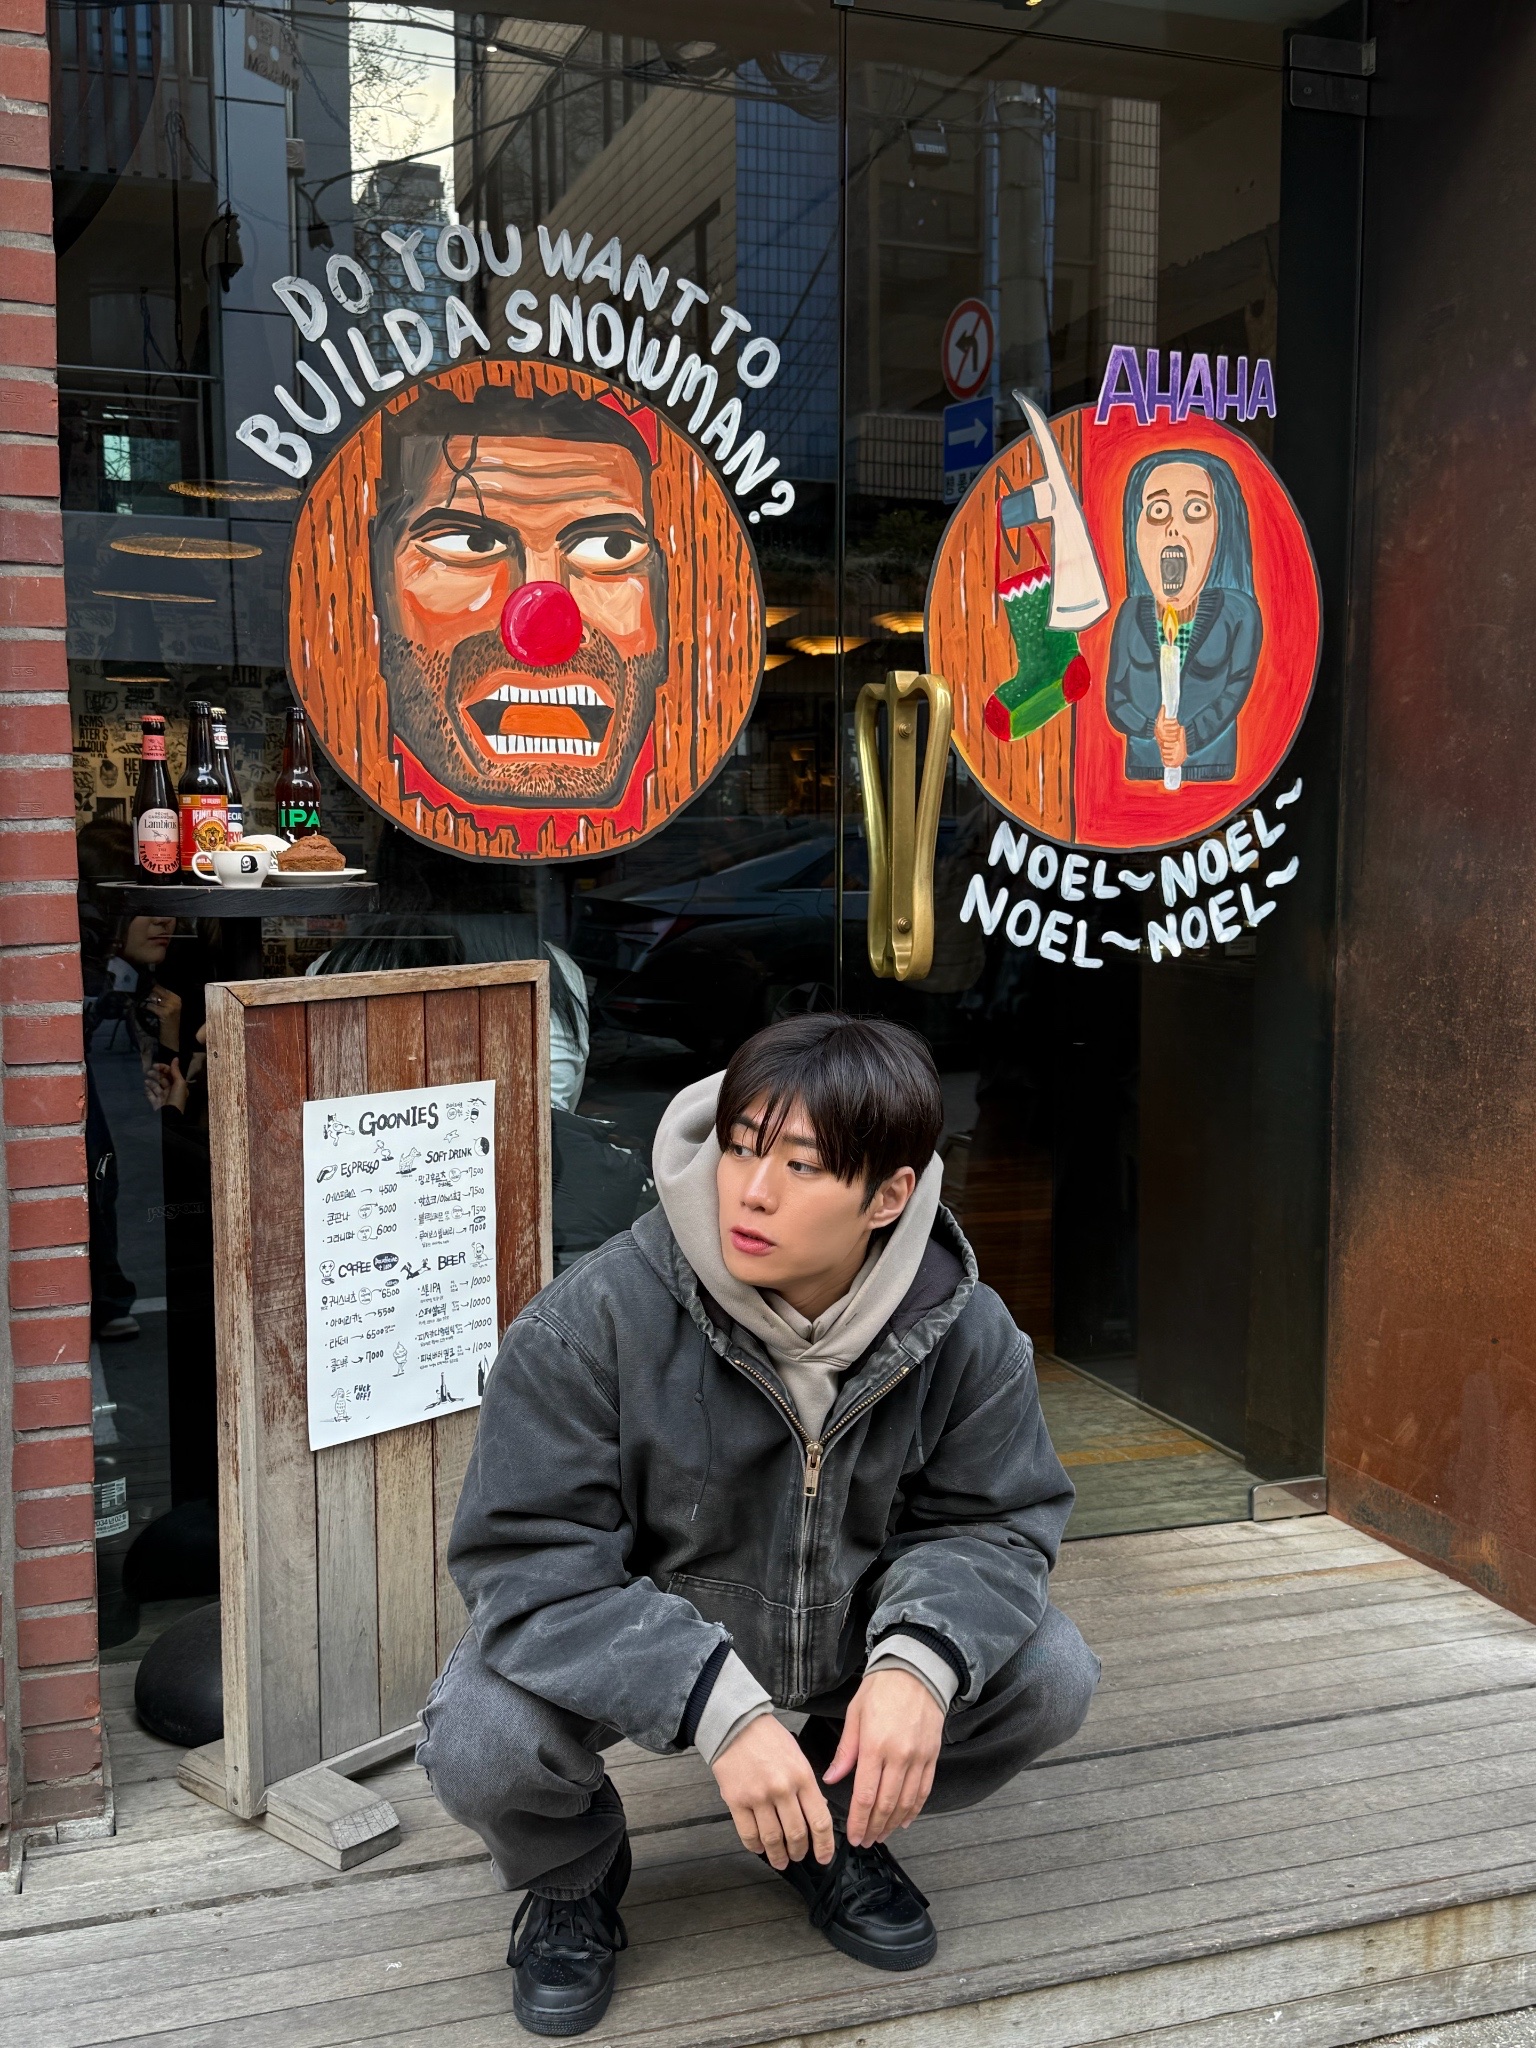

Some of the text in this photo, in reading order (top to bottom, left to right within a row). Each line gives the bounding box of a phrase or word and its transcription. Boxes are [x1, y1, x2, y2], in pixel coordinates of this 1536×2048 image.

[272, 223, 782, 389] DO YOU WANT TO
[1095, 344, 1277, 426] AHAHA
[235, 289, 796, 523] BUILD A SNOWMAN?
[228, 812, 242, 821] ECIAL
[281, 809, 321, 828] IPA
[359, 1102, 439, 1136] GOONIES
[425, 1148, 472, 1164] SOFT DRINK
[341, 1159, 379, 1177] ESPRESSO
[379, 1183, 397, 1195] 4500
[378, 1203, 397, 1215] 5000
[377, 1223, 397, 1236] 6000
[469, 1223, 486, 1234] 7000
[438, 1251, 466, 1270] BEER
[338, 1261, 371, 1278] COFFEE
[381, 1288, 400, 1299] 6500
[470, 1296, 490, 1308] 10000
[377, 1306, 395, 1317] 5500
[471, 1317, 492, 1330] 10000
[366, 1328, 384, 1339] 6500
[472, 1342, 491, 1354] 11000
[366, 1350, 384, 1363] 7000
